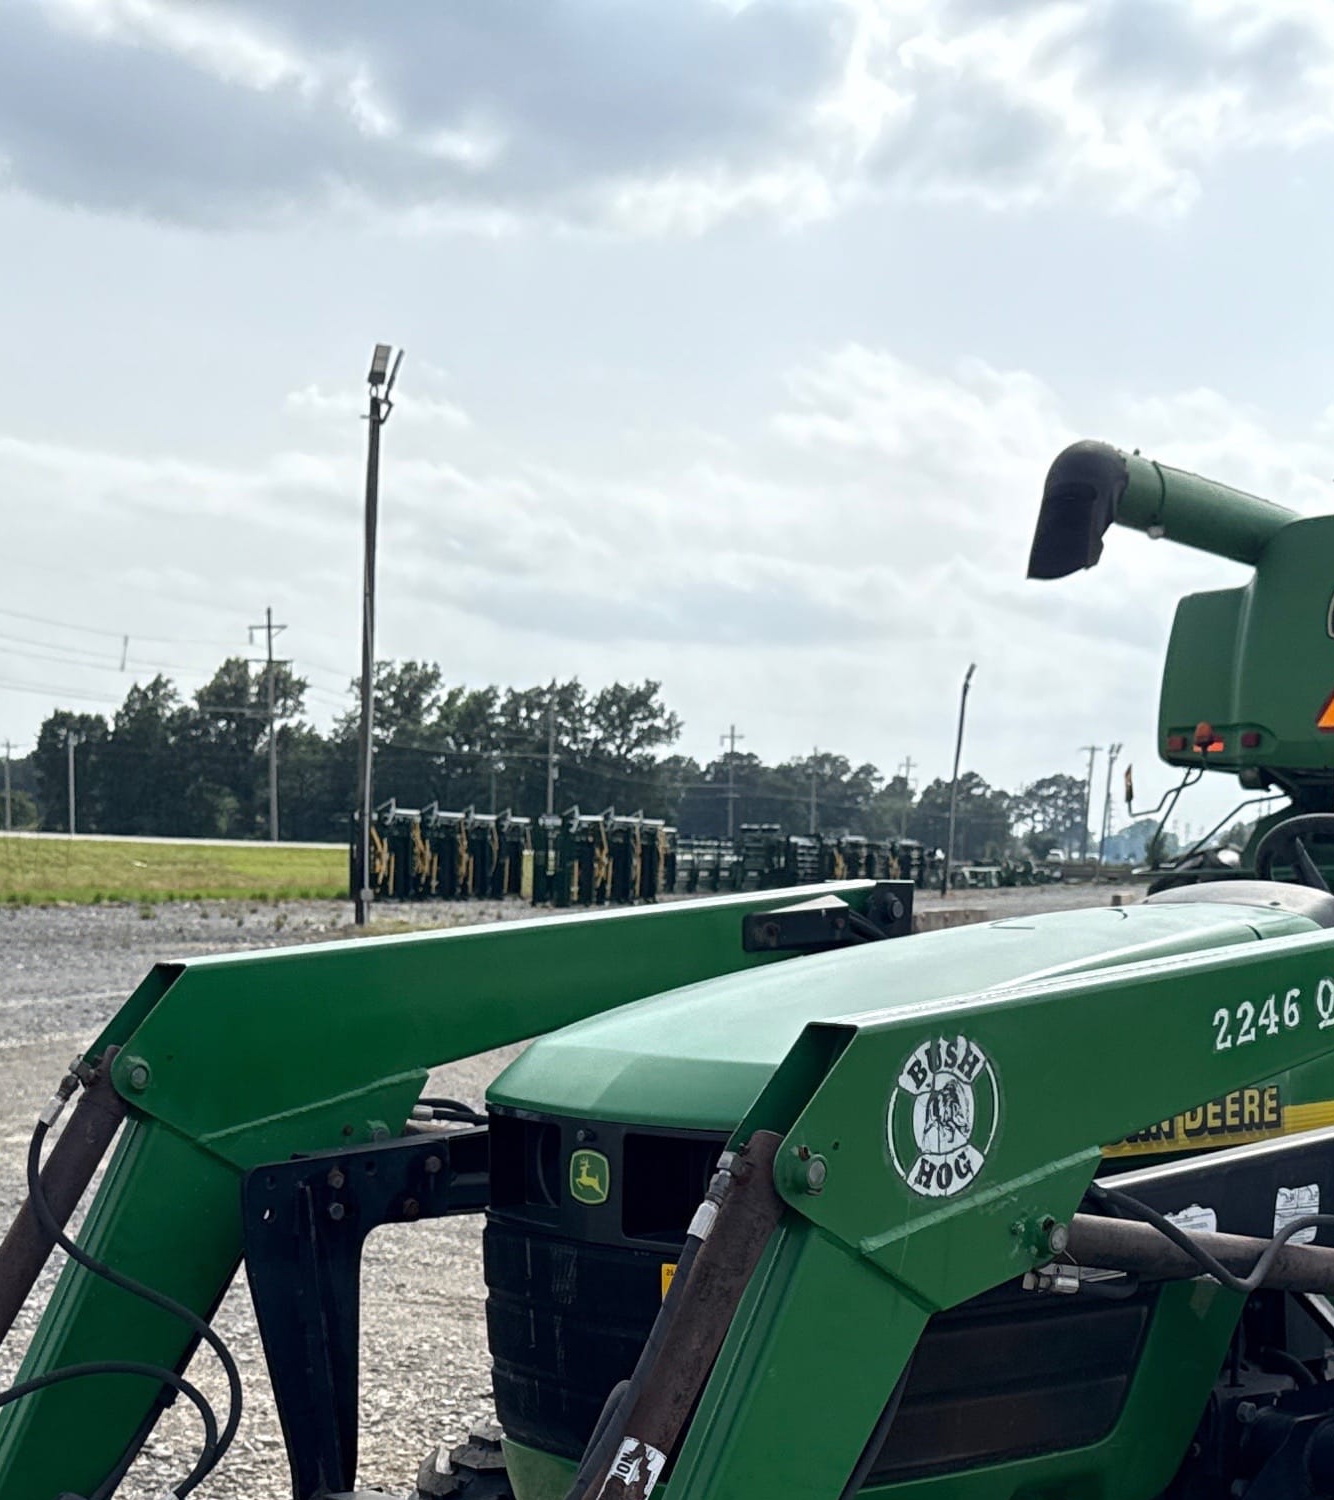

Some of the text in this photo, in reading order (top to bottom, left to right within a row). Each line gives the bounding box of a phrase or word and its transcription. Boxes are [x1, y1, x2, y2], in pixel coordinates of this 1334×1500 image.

[1212, 988, 1301, 1051] 2246
[907, 1037, 981, 1091] BUSH
[914, 1151, 976, 1190] HOG
